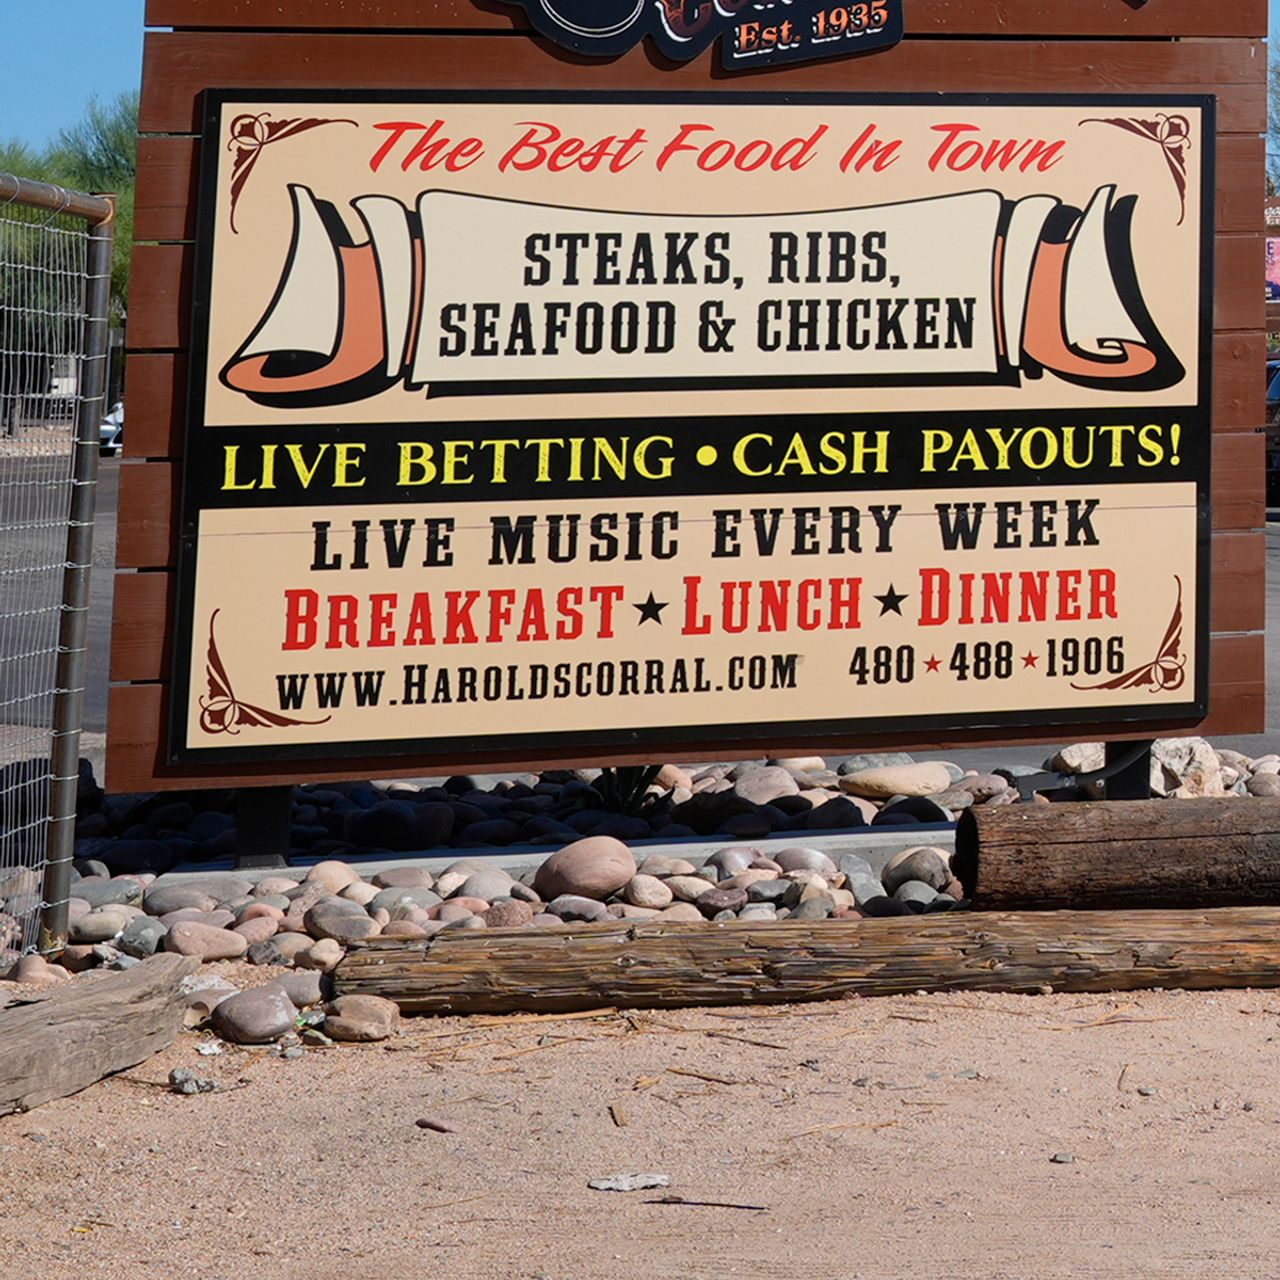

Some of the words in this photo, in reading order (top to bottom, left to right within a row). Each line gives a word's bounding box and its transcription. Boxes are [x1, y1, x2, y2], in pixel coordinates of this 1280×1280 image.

[734, 18, 801, 56] Est.
[811, 0, 890, 44] 1935
[368, 119, 486, 173] The
[498, 121, 649, 173] Best
[655, 123, 830, 173] Food
[838, 123, 903, 173] In
[927, 123, 1067, 173] Town
[523, 231, 744, 289] STEAKS,
[767, 231, 901, 287] RIBS,
[439, 301, 676, 357] SEAFOOD
[698, 299, 737, 353] &
[757, 296, 976, 352] CHICKEN
[220, 442, 367, 491] LIVE
[396, 436, 675, 486] BETTING
[732, 430, 890, 477] CASH
[920, 423, 1182, 474] PAYOUTS!
[310, 517, 456, 571] LIVE
[488, 510, 680, 566] MUSIC
[711, 504, 903, 558] EVERY
[934, 498, 1100, 550] WEEK
[281, 585, 625, 650] BREAKFAST
[681, 575, 863, 635] LUNCH
[917, 567, 1118, 626] DINNER
[276, 654, 799, 710] WWW.HAROLDSCORRAL.COM
[849, 644, 915, 685] 480
[948, 640, 1014, 681] 488
[1045, 636, 1125, 677] 1906
